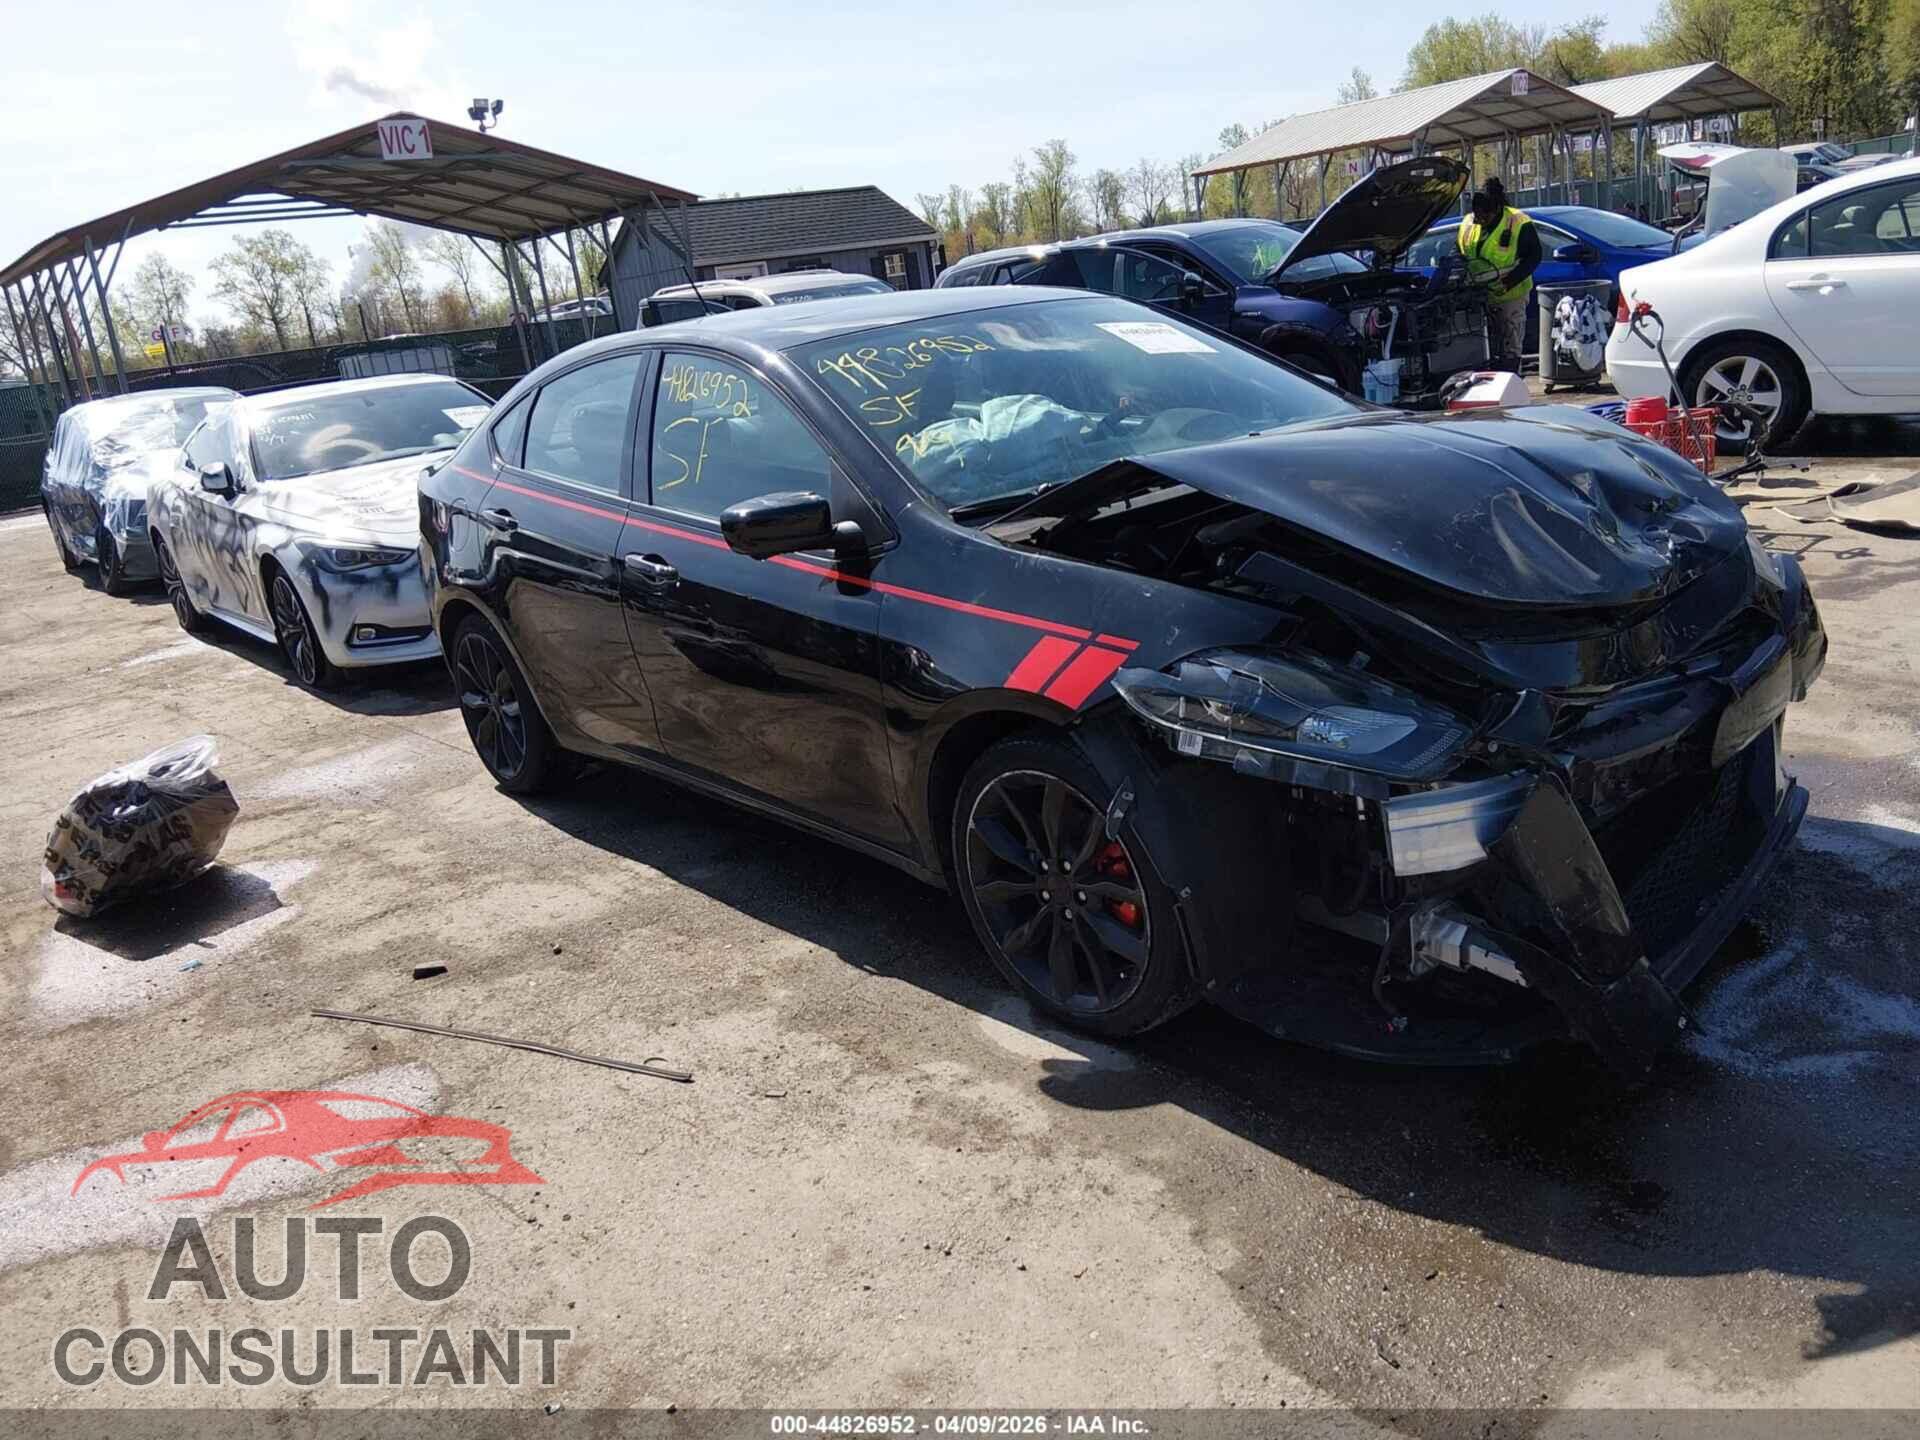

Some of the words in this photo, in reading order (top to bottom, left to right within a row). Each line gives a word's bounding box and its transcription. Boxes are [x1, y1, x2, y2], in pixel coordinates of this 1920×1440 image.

[379, 125, 415, 154] VIC
[418, 124, 430, 153] 1
[860, 388, 921, 425] SF
